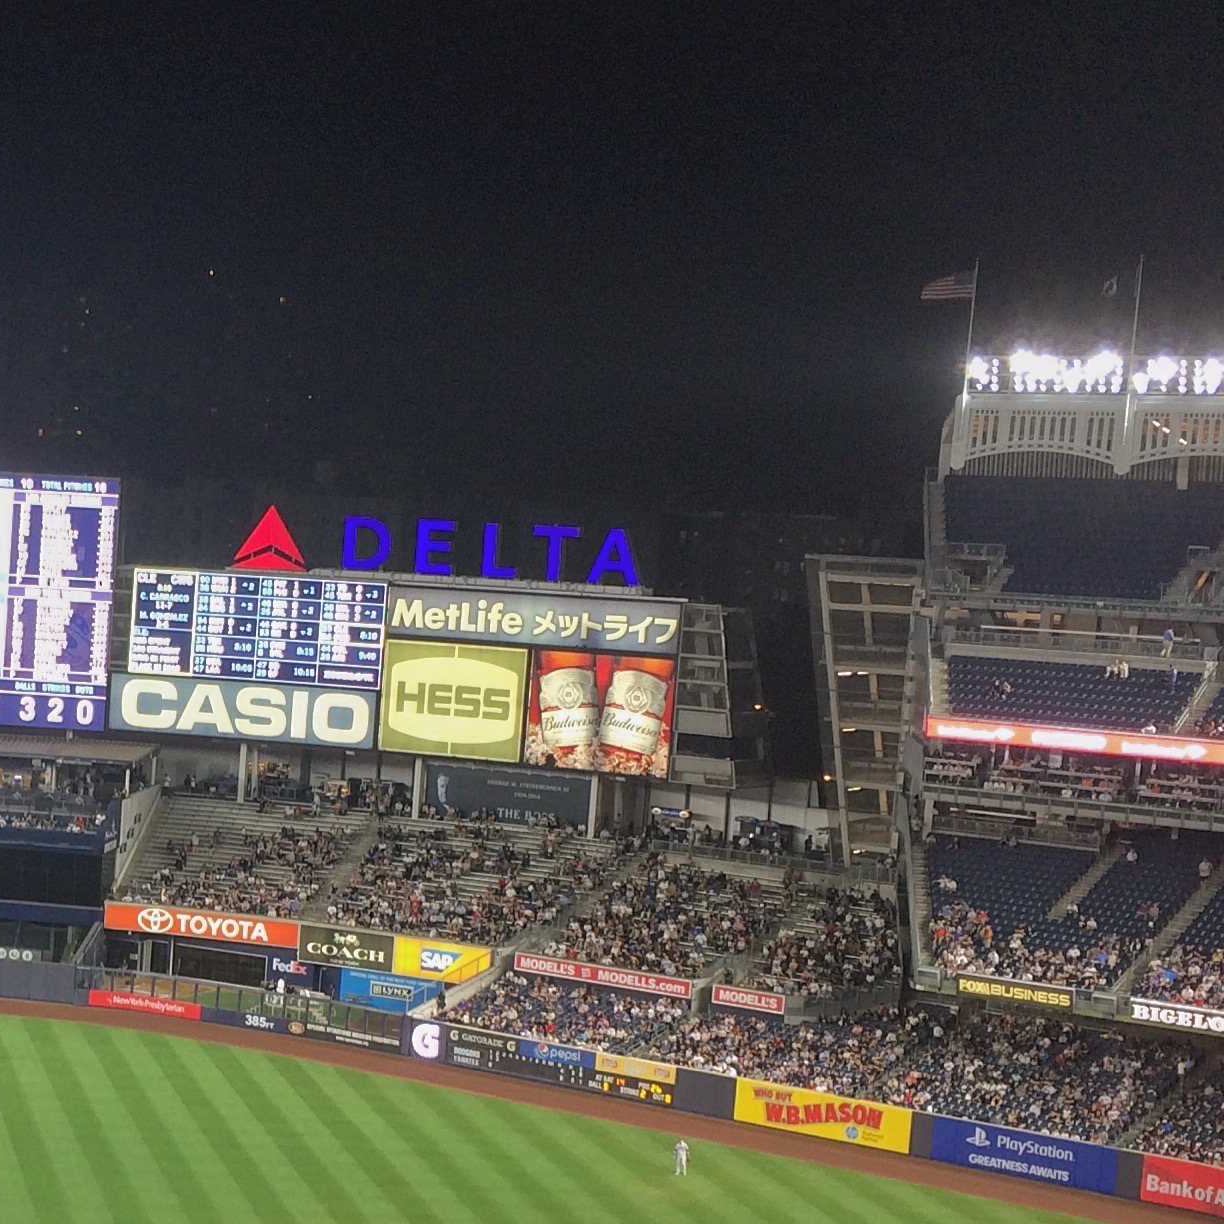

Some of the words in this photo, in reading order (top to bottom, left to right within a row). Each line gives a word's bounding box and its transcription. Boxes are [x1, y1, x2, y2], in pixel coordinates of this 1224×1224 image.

[342, 515, 640, 586] DELTA
[391, 598, 523, 635] MetLife
[533, 610, 678, 644] メットライフ
[19, 696, 36, 722] 3
[47, 698, 64, 723] 2
[76, 700, 94, 725] 0
[121, 678, 370, 744] CASIO
[396, 680, 511, 721] HESS
[543, 714, 599, 732] Budweiser
[601, 712, 660, 737] Budweiser
[496, 807, 521, 820] THE
[176, 913, 269, 942] TOYOTA
[306, 942, 385, 963] COACH
[421, 951, 453, 969] SAP
[520, 957, 575, 976] MODELL'S
[272, 958, 307, 976] FedEx
[382, 985, 409, 997] LYNX
[597, 970, 685, 995] MODELLS.com
[959, 979, 987, 995] FOX
[991, 984, 1071, 1007] BUSINESS
[718, 990, 777, 1010] MODELL'S
[1131, 1004, 1224, 1032] BIGELO
[411, 1023, 440, 1059] G
[462, 1031, 504, 1048] GATORADE
[550, 1047, 581, 1061] pepsi
[753, 1088, 773, 1099] WHO
[775, 1092, 793, 1102] BUT
[765, 1102, 884, 1130] W.B.MASON
[997, 1134, 1073, 1162] PlayStation
[968, 1153, 1029, 1174] GREATNESS
[1029, 1165, 1070, 1182] AWAITS
[1146, 1174, 1193, 1198] Bank
[1195, 1183, 1213, 1202] of
